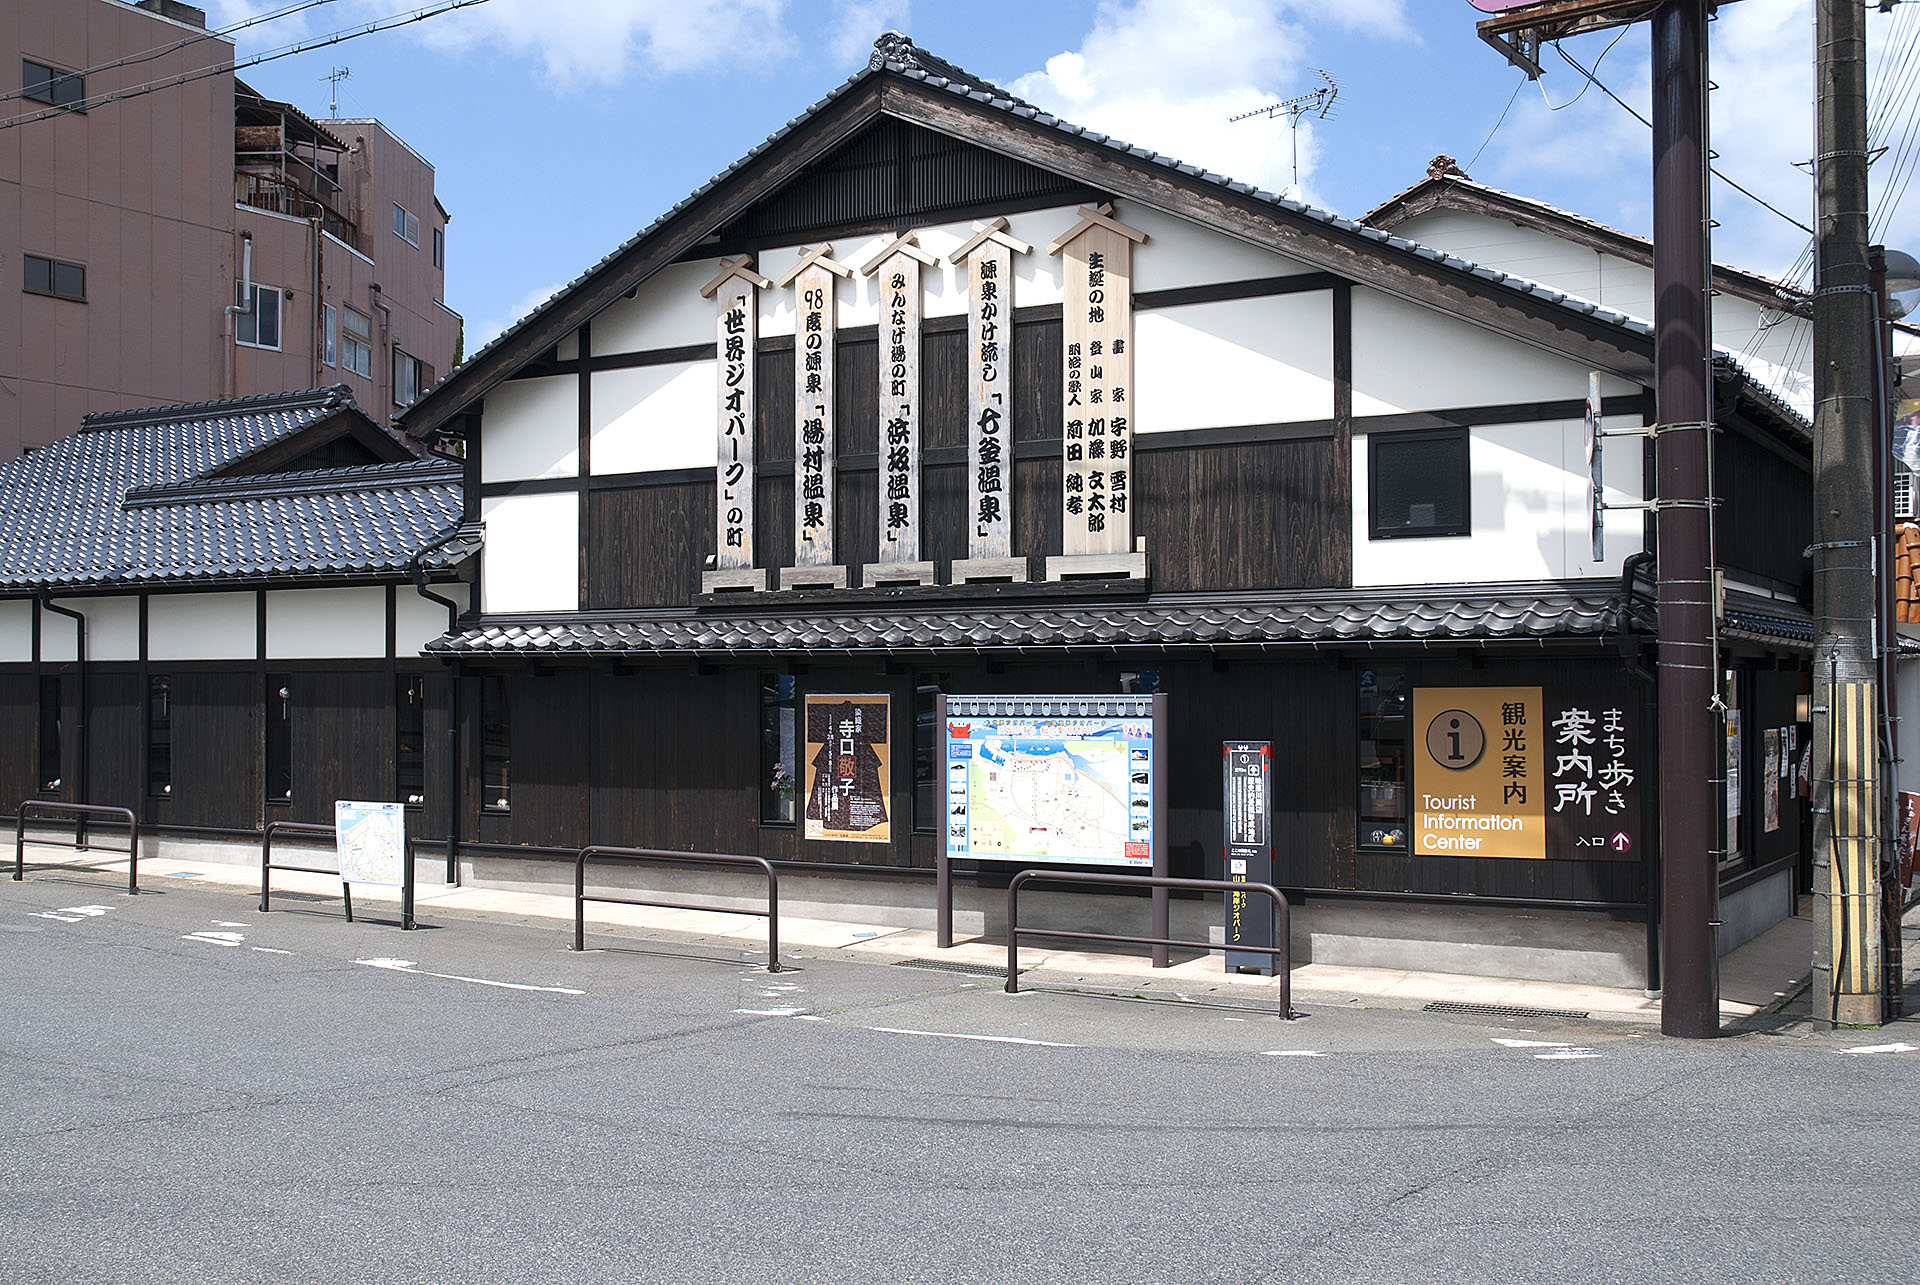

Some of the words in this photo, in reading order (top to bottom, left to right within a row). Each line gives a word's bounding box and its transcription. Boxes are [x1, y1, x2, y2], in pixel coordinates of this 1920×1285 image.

[1088, 251, 1105, 323] 生誕の地
[838, 719, 856, 797] 寺口敬子
[1502, 702, 1527, 805] 観光案内
[1552, 707, 1598, 816] 案内所
[1598, 708, 1634, 815] まち歩き
[1423, 794, 1476, 810] Tourist
[1423, 813, 1523, 831] Information
[1422, 834, 1483, 851] Center
[1576, 836, 1605, 847] 入口
[1232, 875, 1241, 942] 山海岸ジオパーク
